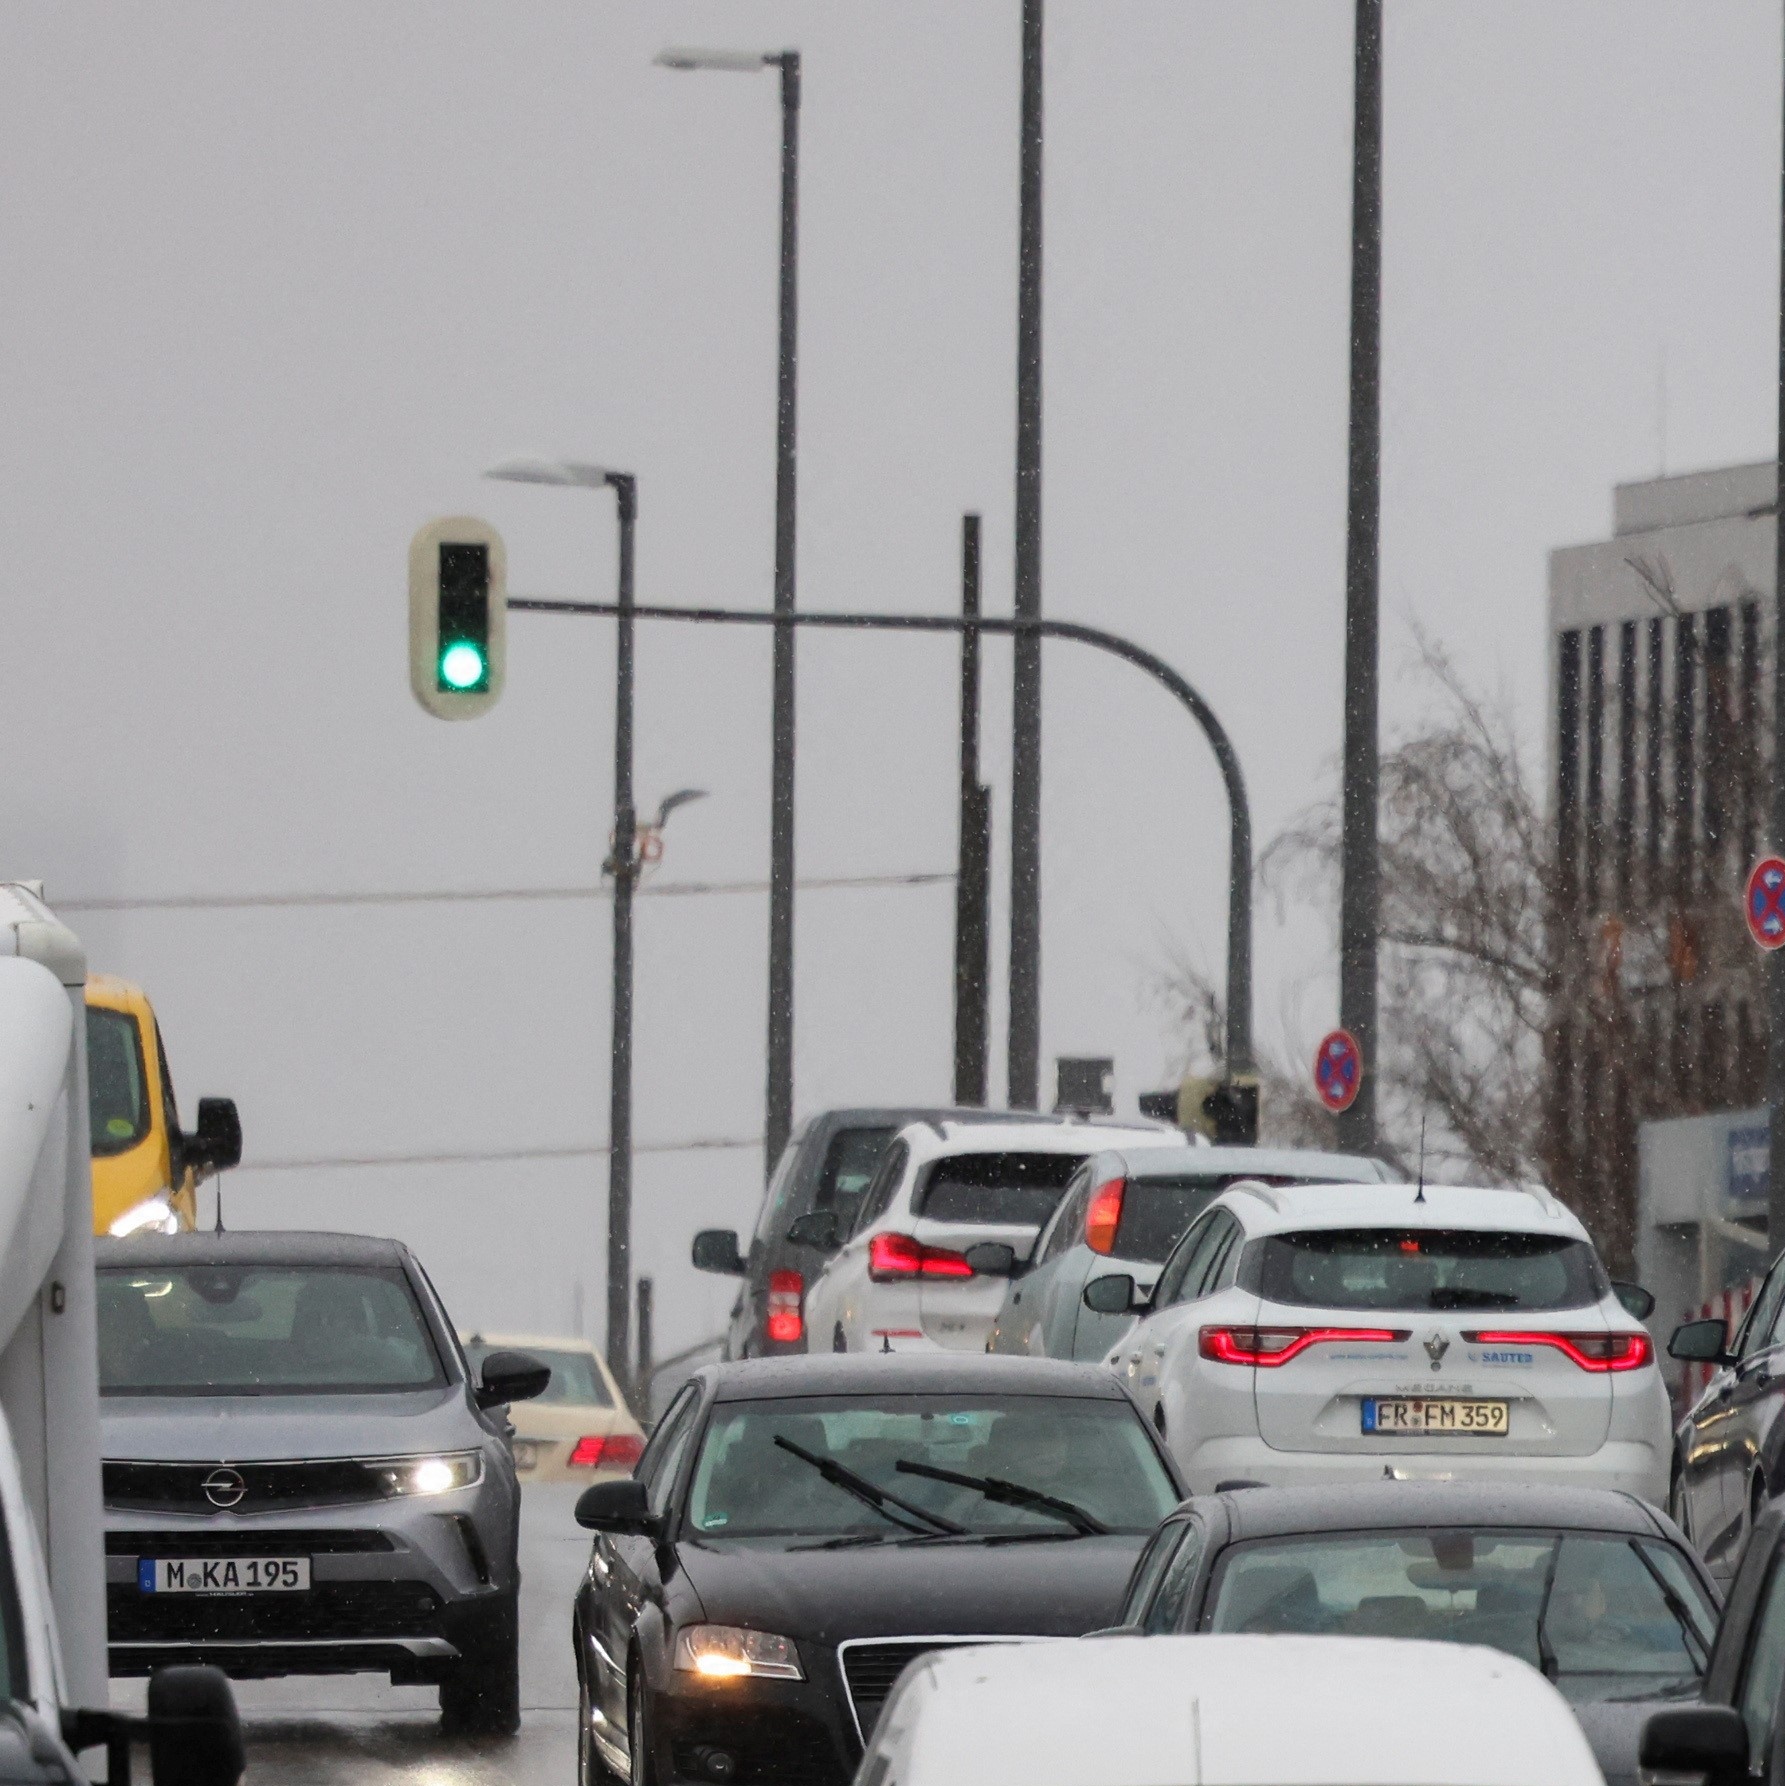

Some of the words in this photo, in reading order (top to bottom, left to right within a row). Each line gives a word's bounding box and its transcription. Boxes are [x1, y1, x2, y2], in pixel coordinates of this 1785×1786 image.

[1460, 1404, 1505, 1428] 359
[166, 1561, 185, 1589] M
[202, 1561, 241, 1588] KA
[245, 1560, 300, 1588] 195
